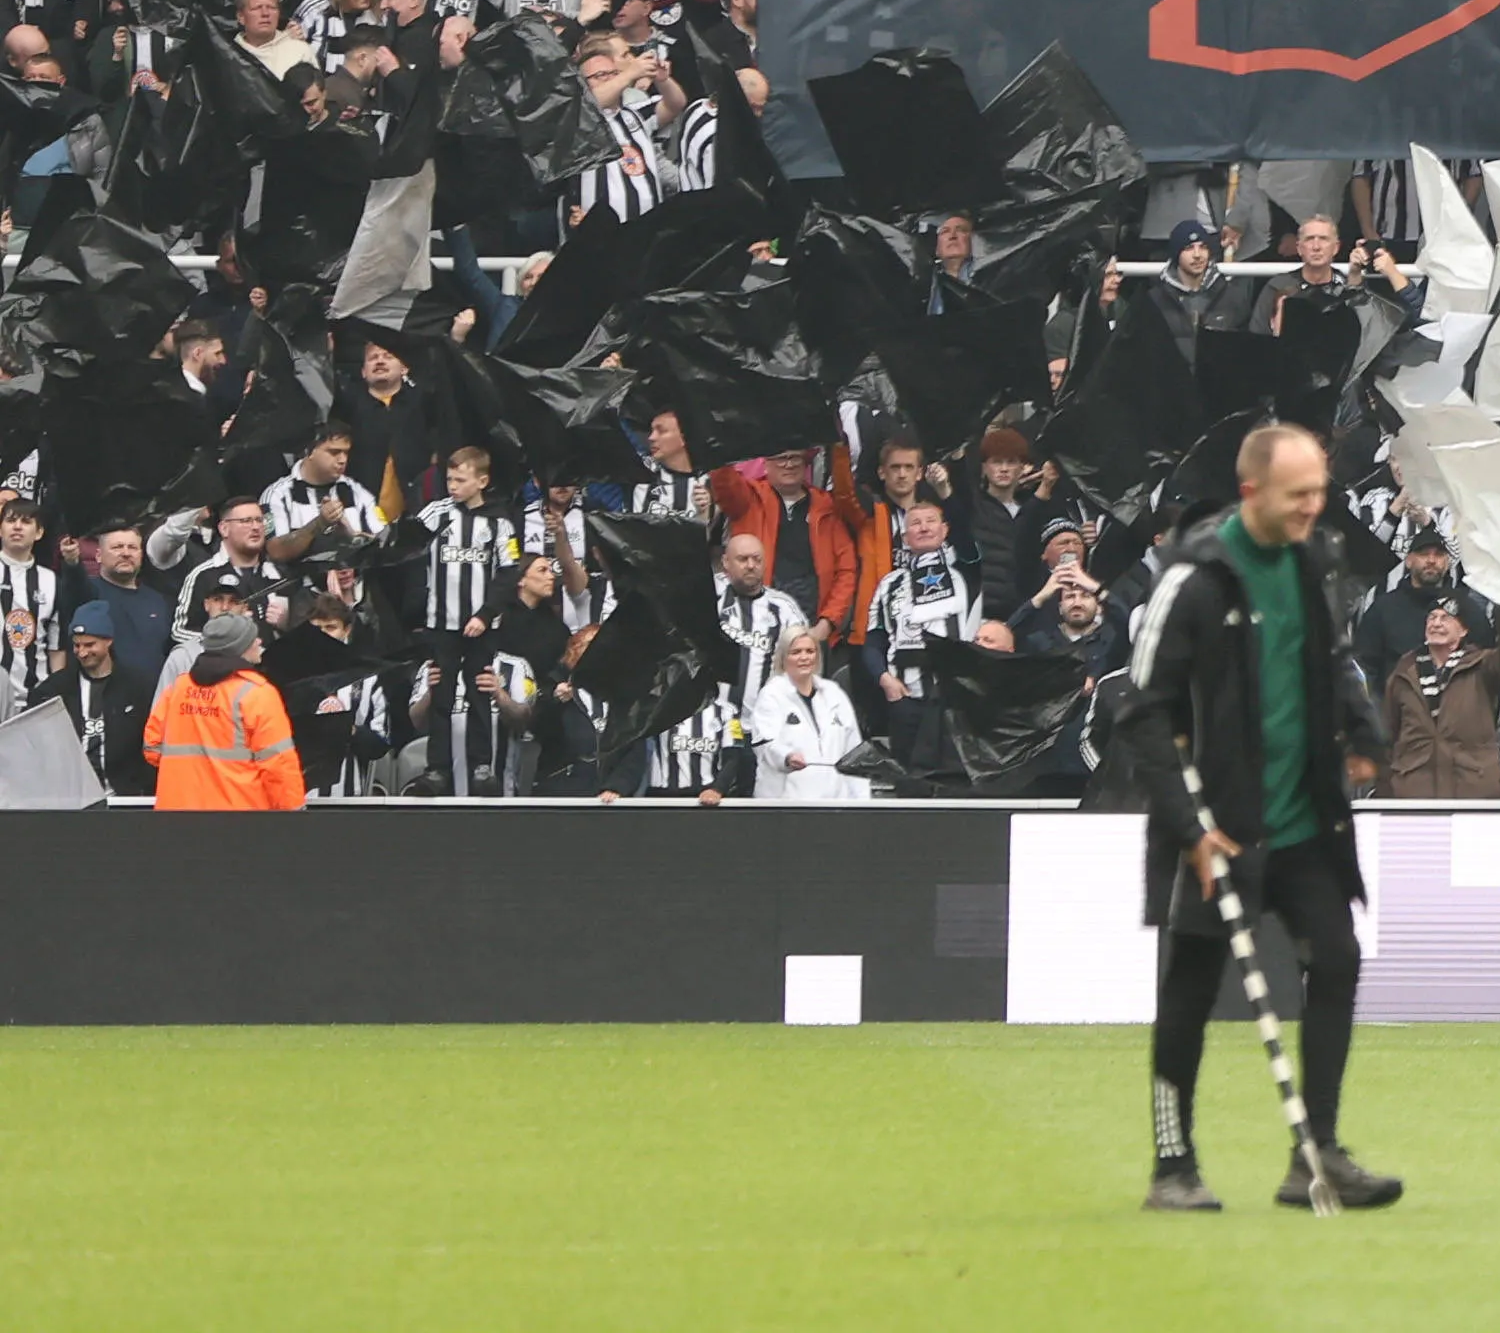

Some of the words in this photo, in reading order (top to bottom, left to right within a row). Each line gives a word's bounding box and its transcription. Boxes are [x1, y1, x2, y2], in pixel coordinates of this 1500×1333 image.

[457, 548, 489, 564] sela
[85, 718, 106, 735] se
[686, 736, 720, 753] sela
